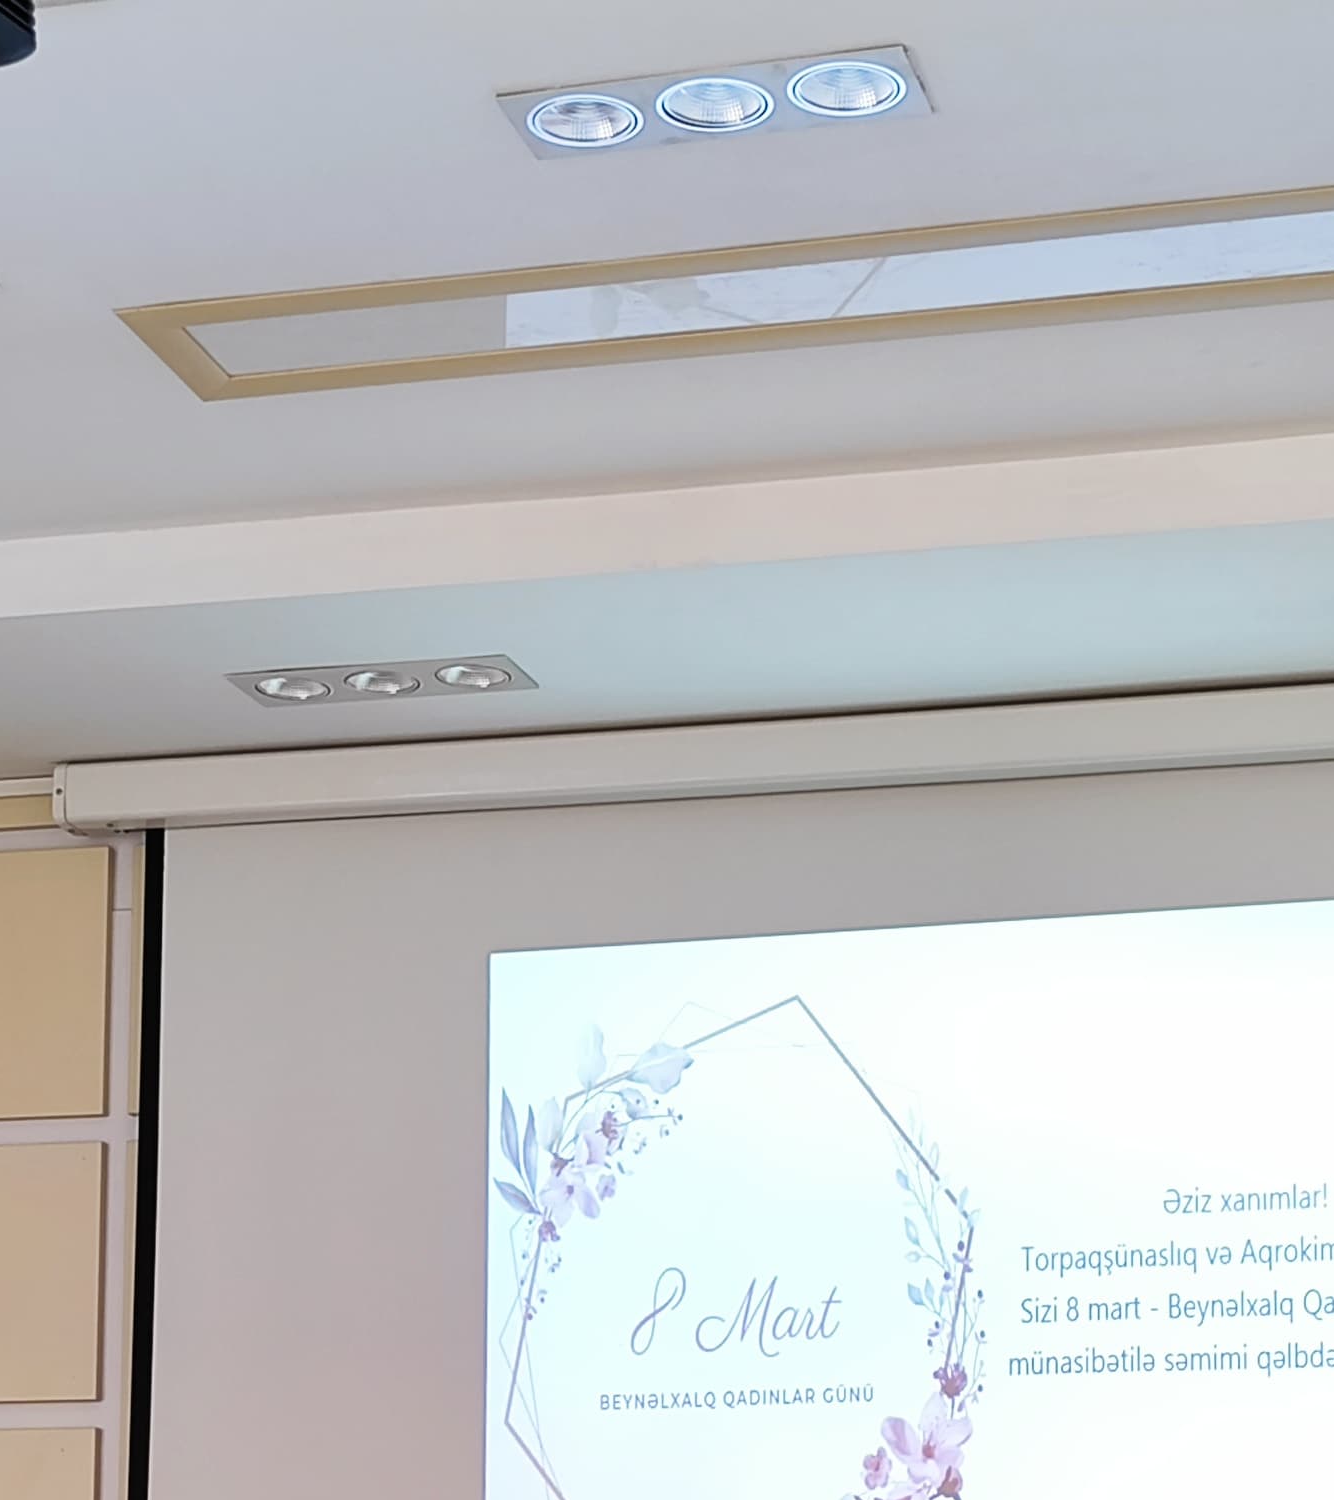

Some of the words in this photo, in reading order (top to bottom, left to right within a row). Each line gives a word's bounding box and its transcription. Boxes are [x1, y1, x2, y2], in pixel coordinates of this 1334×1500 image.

[1162, 1185, 1213, 1217] Əziz
[1219, 1182, 1328, 1214] xanımlar!
[1019, 1239, 1198, 1280] Torpaqşünaslıq
[1204, 1244, 1234, 1267] və
[629, 1266, 687, 1357] 8
[694, 1274, 844, 1359] Mart
[1020, 1295, 1059, 1326] Sizi
[1065, 1295, 1081, 1323] 8
[1087, 1296, 1142, 1323] mart
[1167, 1288, 1295, 1328] Beynəlxalq
[1008, 1344, 1156, 1377] münasibətilə
[1163, 1342, 1248, 1373] səmimi
[599, 1390, 718, 1412] BEYNƏLXALQ
[722, 1387, 817, 1410] QADINLAR
[821, 1382, 876, 1405] GÜNÜ
